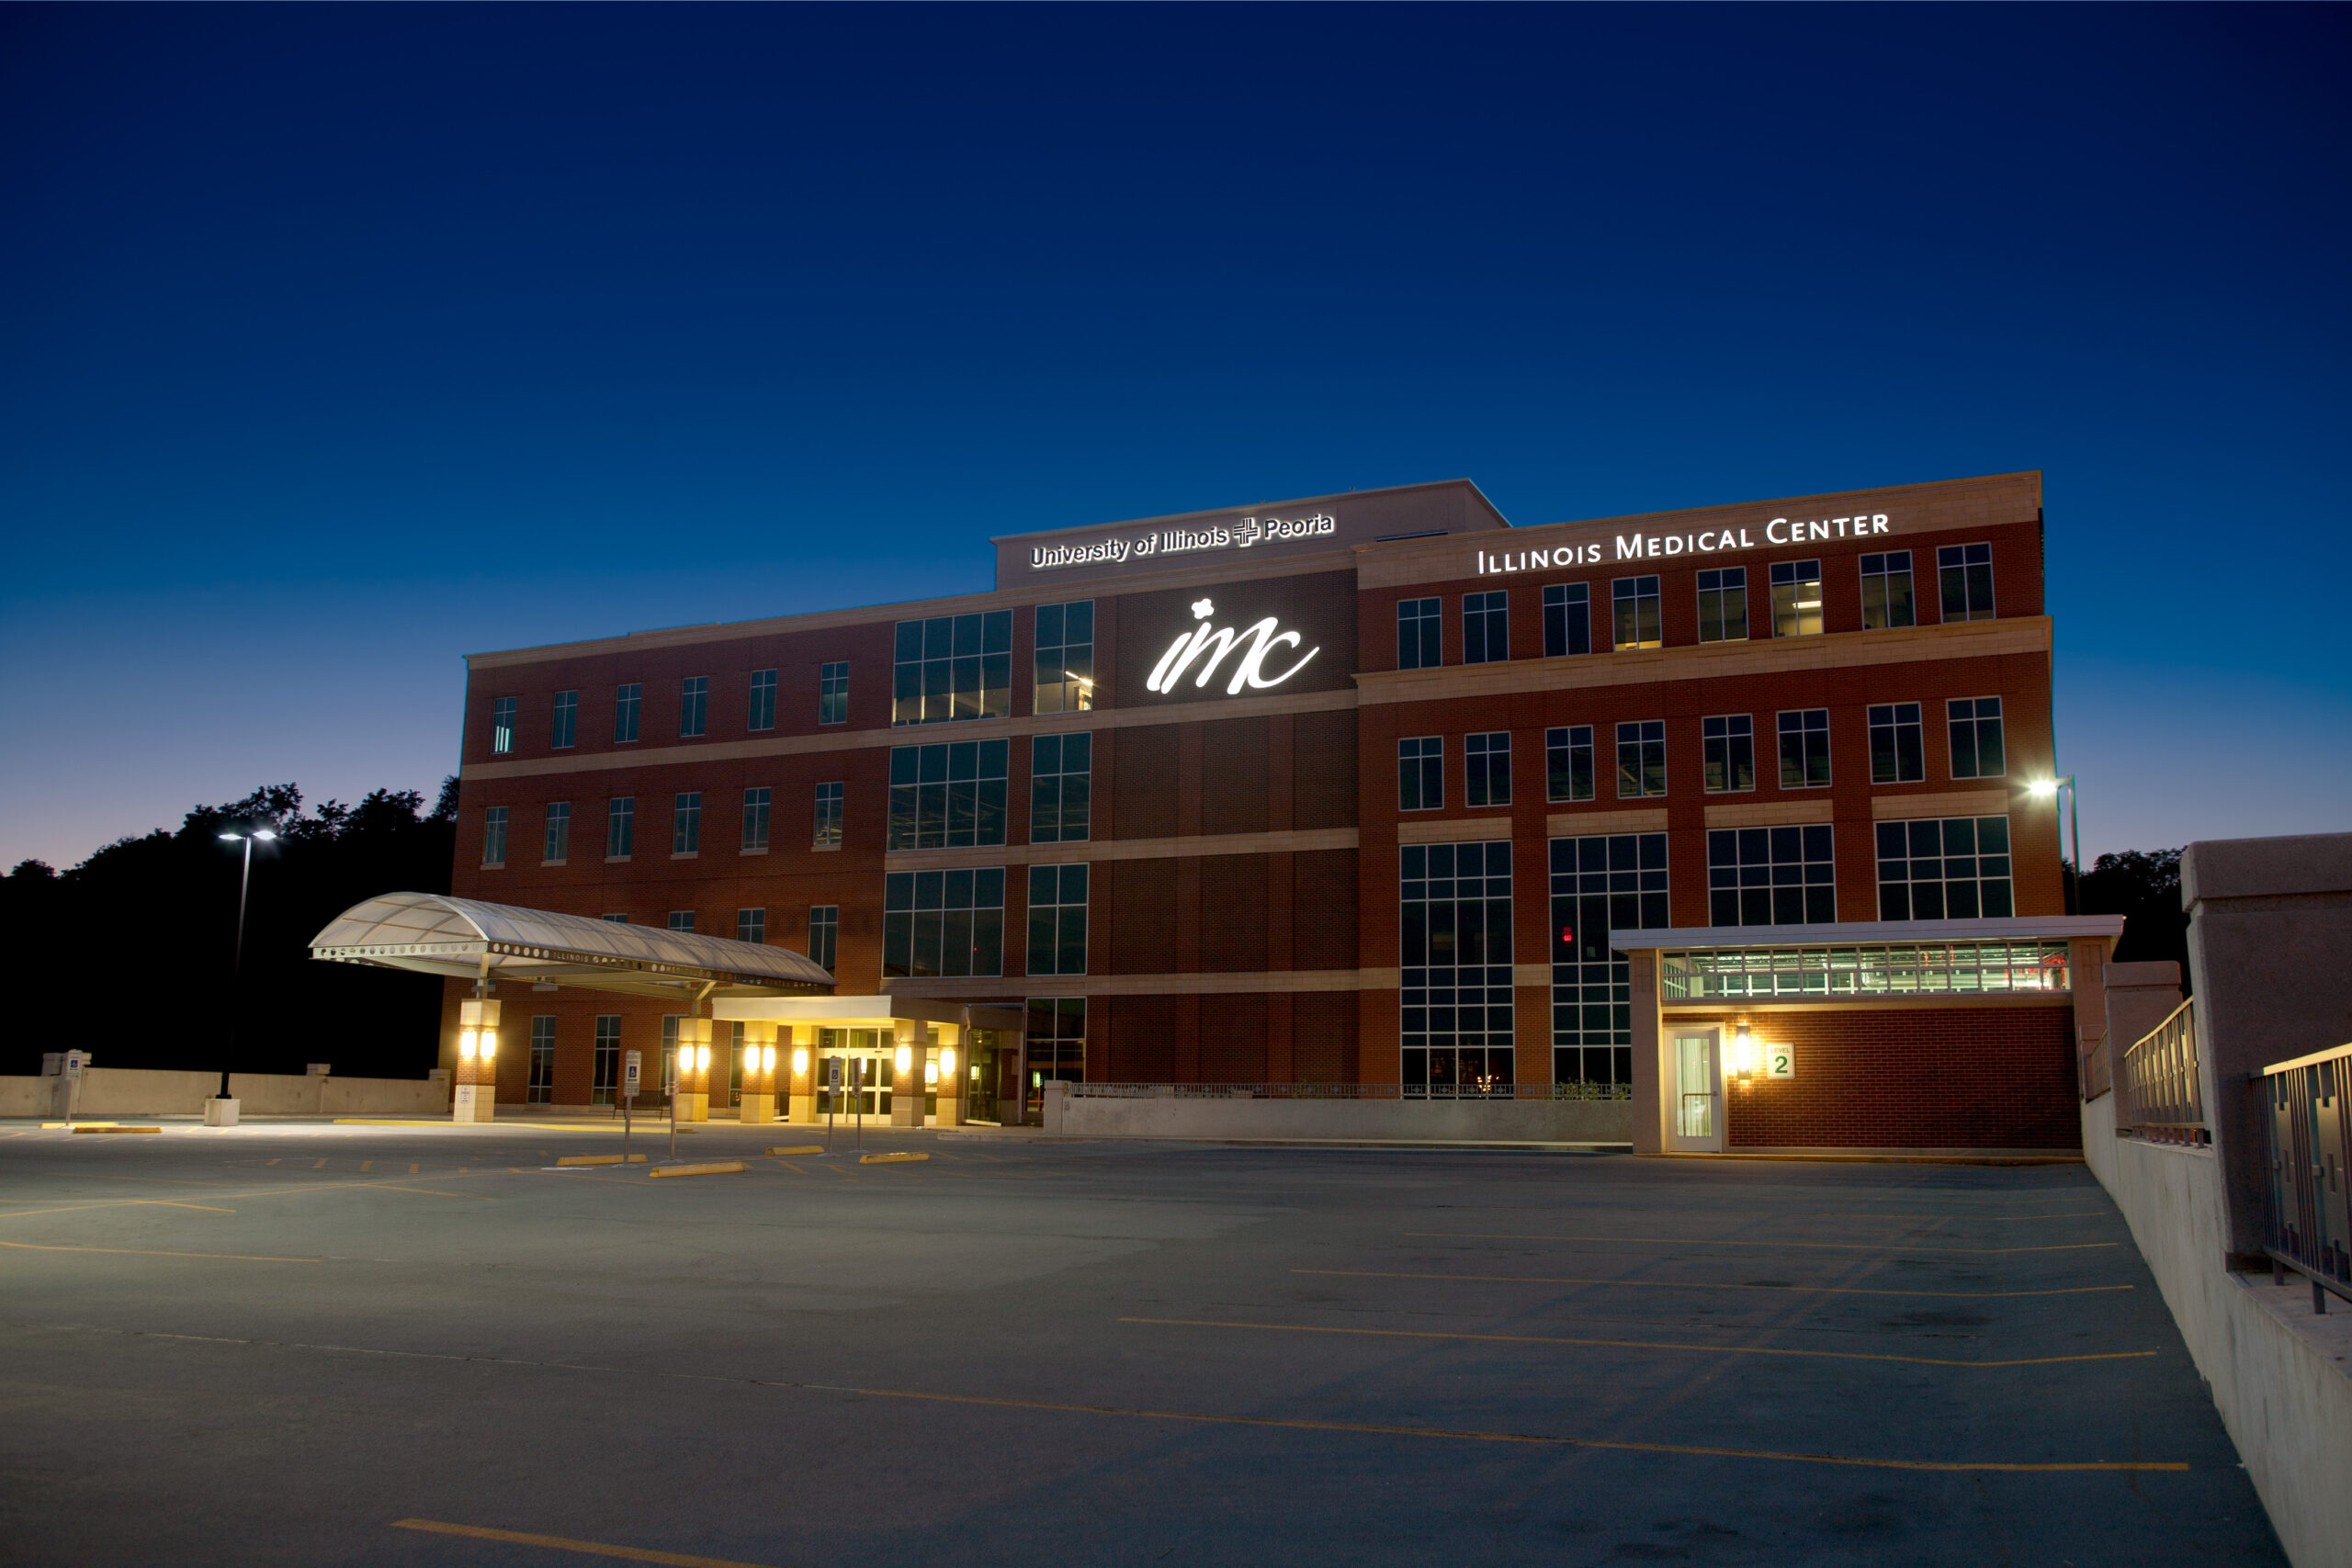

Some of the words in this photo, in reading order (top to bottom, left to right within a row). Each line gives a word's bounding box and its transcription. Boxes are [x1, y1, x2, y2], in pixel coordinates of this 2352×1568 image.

[1030, 539, 1129, 569] University
[1134, 533, 1159, 556] of
[1160, 526, 1228, 552] Illinois
[1263, 513, 1334, 539] Peoria
[1477, 544, 1601, 574] ILLINOIS
[1616, 528, 1754, 560] MEDICAL
[1766, 513, 1889, 545] CENTER
[1146, 598, 1320, 695] imc
[553, 951, 589, 964] ILLINOIS
[1775, 1055, 1788, 1074] 2
